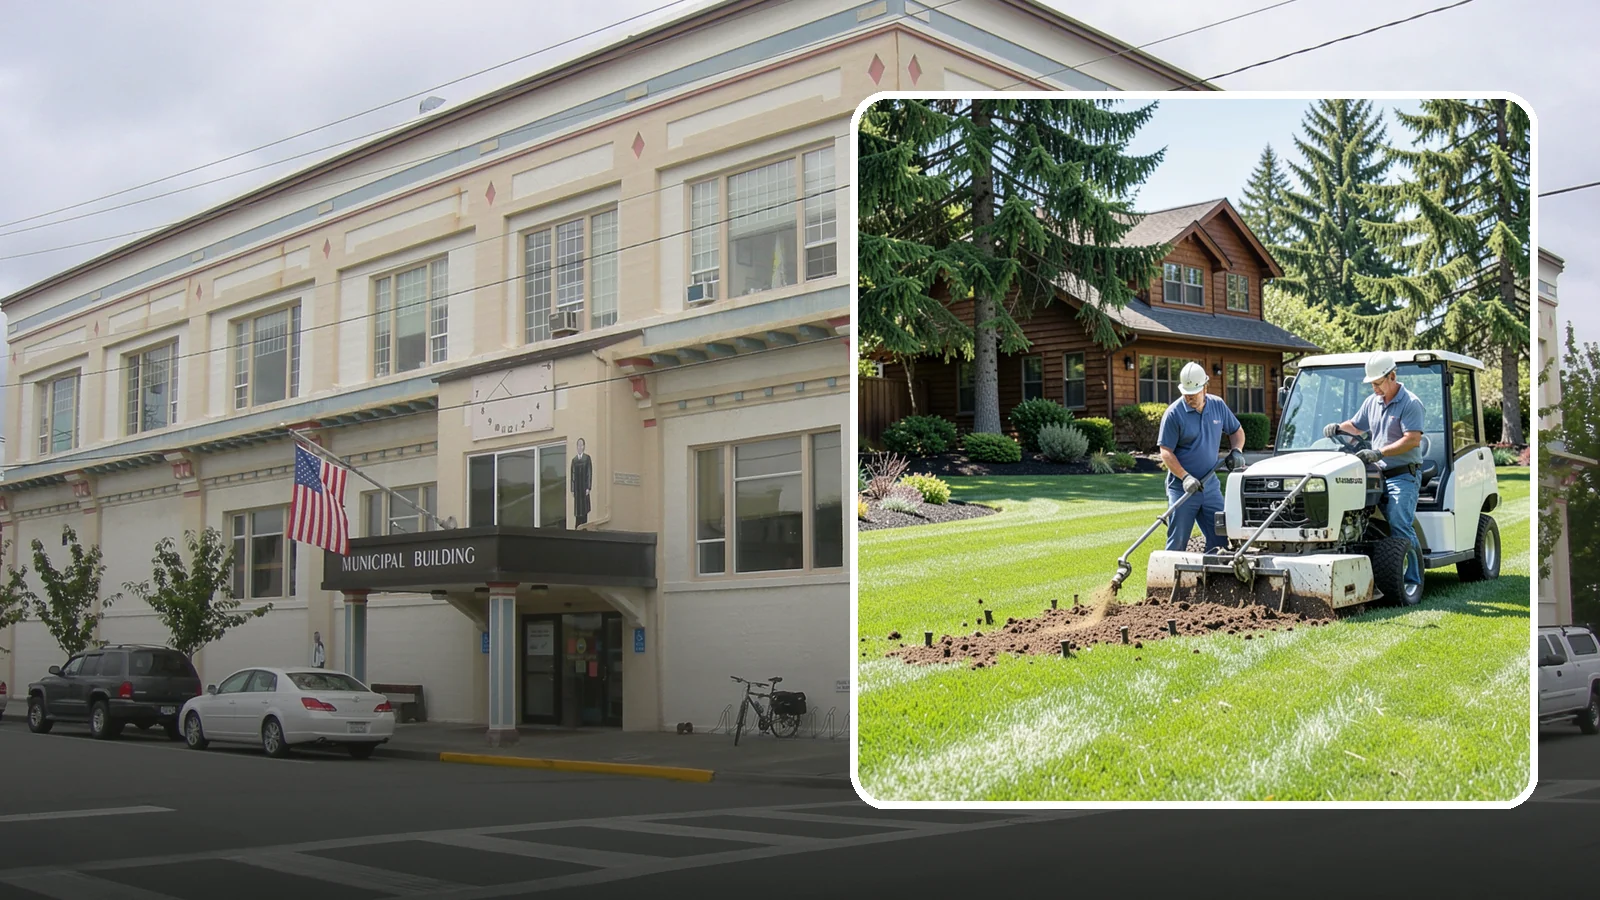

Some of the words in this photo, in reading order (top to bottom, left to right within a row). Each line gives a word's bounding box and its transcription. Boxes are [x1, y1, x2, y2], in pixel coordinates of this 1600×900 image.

[480, 406, 485, 415] 8
[487, 417, 493, 426] 9
[528, 413, 533, 422] 3
[521, 420, 526, 428] 2
[507, 425, 513, 433] 12
[342, 552, 405, 572] MUNICIPAL
[414, 546, 475, 567] BUILDING
